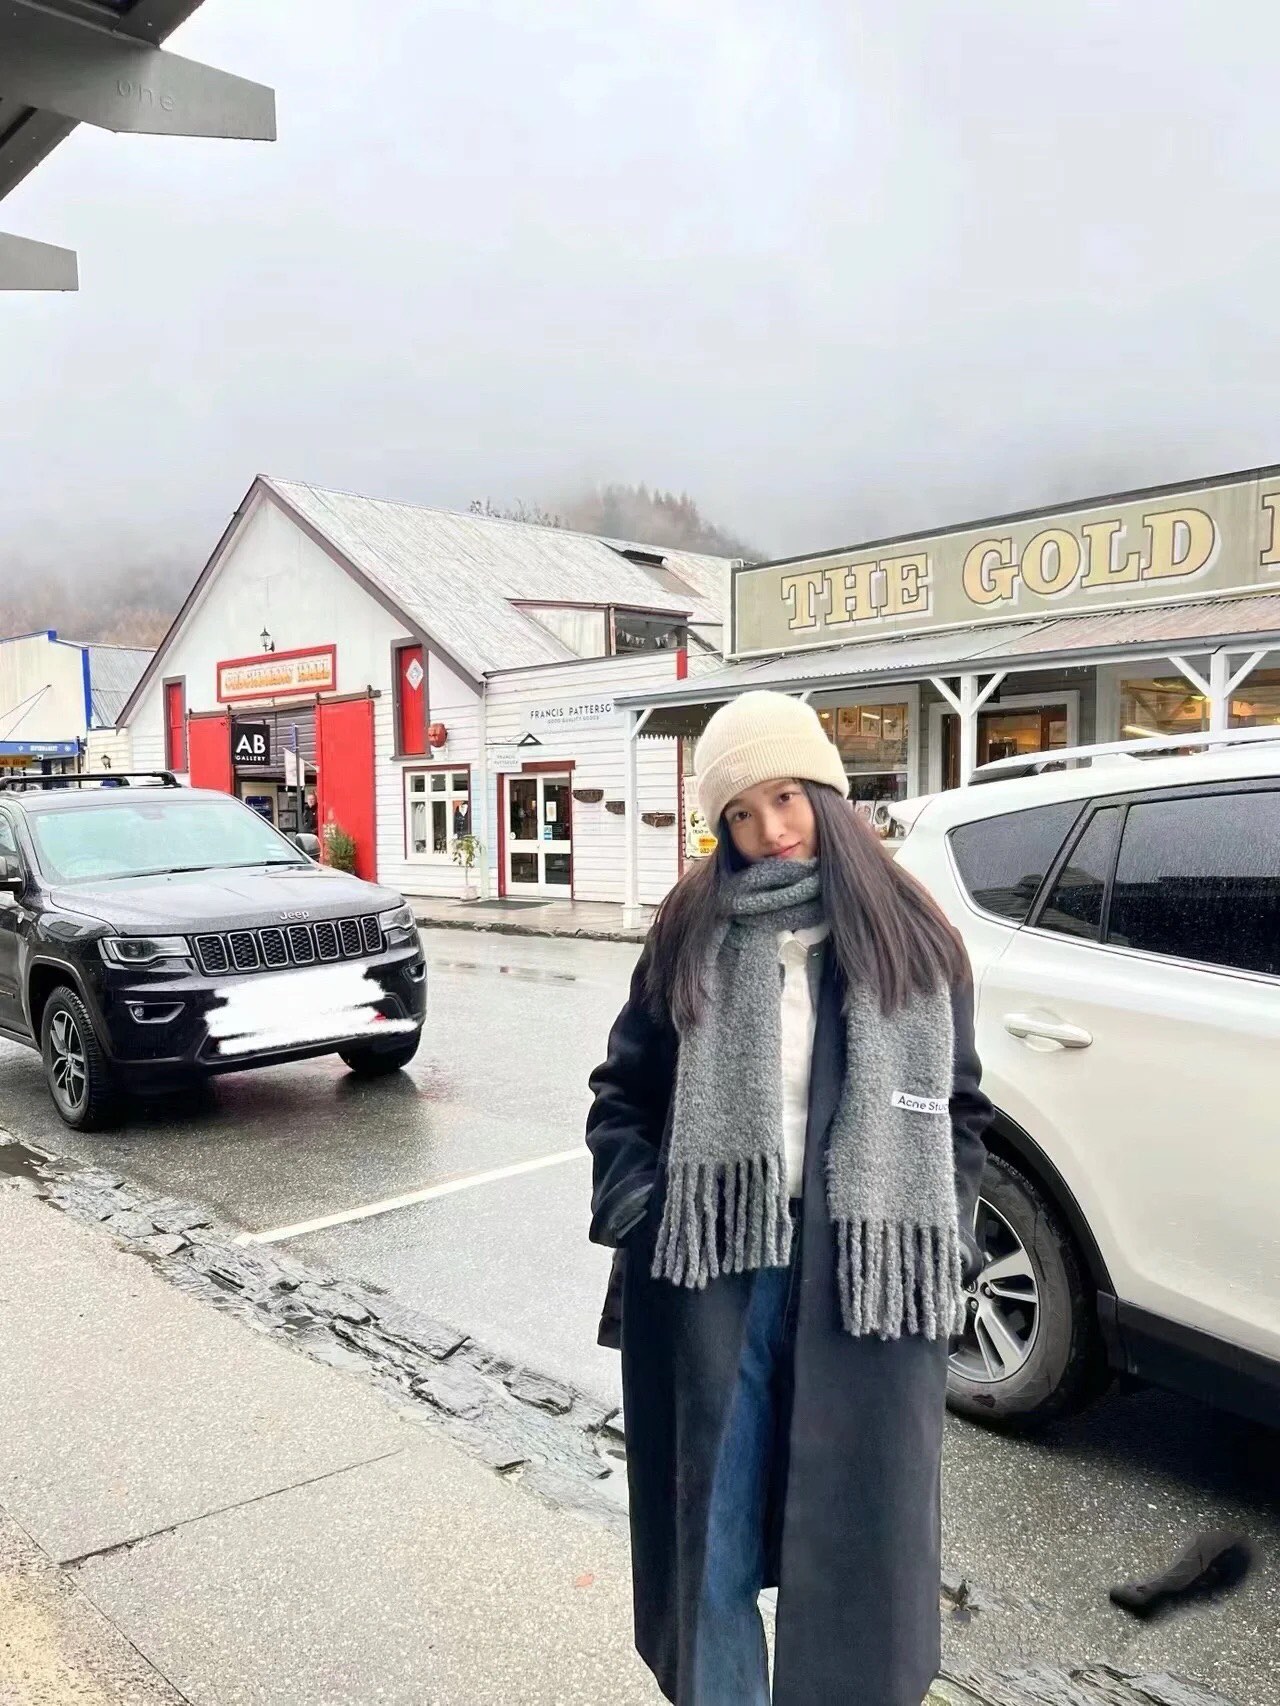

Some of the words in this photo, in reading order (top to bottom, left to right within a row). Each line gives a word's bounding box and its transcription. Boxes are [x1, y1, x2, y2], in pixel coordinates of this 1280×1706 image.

[781, 552, 931, 632] THE
[961, 508, 1218, 606] GOLD
[531, 708, 564, 719] FRANCIS
[569, 703, 612, 715] PATTERSO
[235, 734, 266, 754] AB
[280, 910, 310, 921] Jeep
[897, 1095, 927, 1110] Acne
